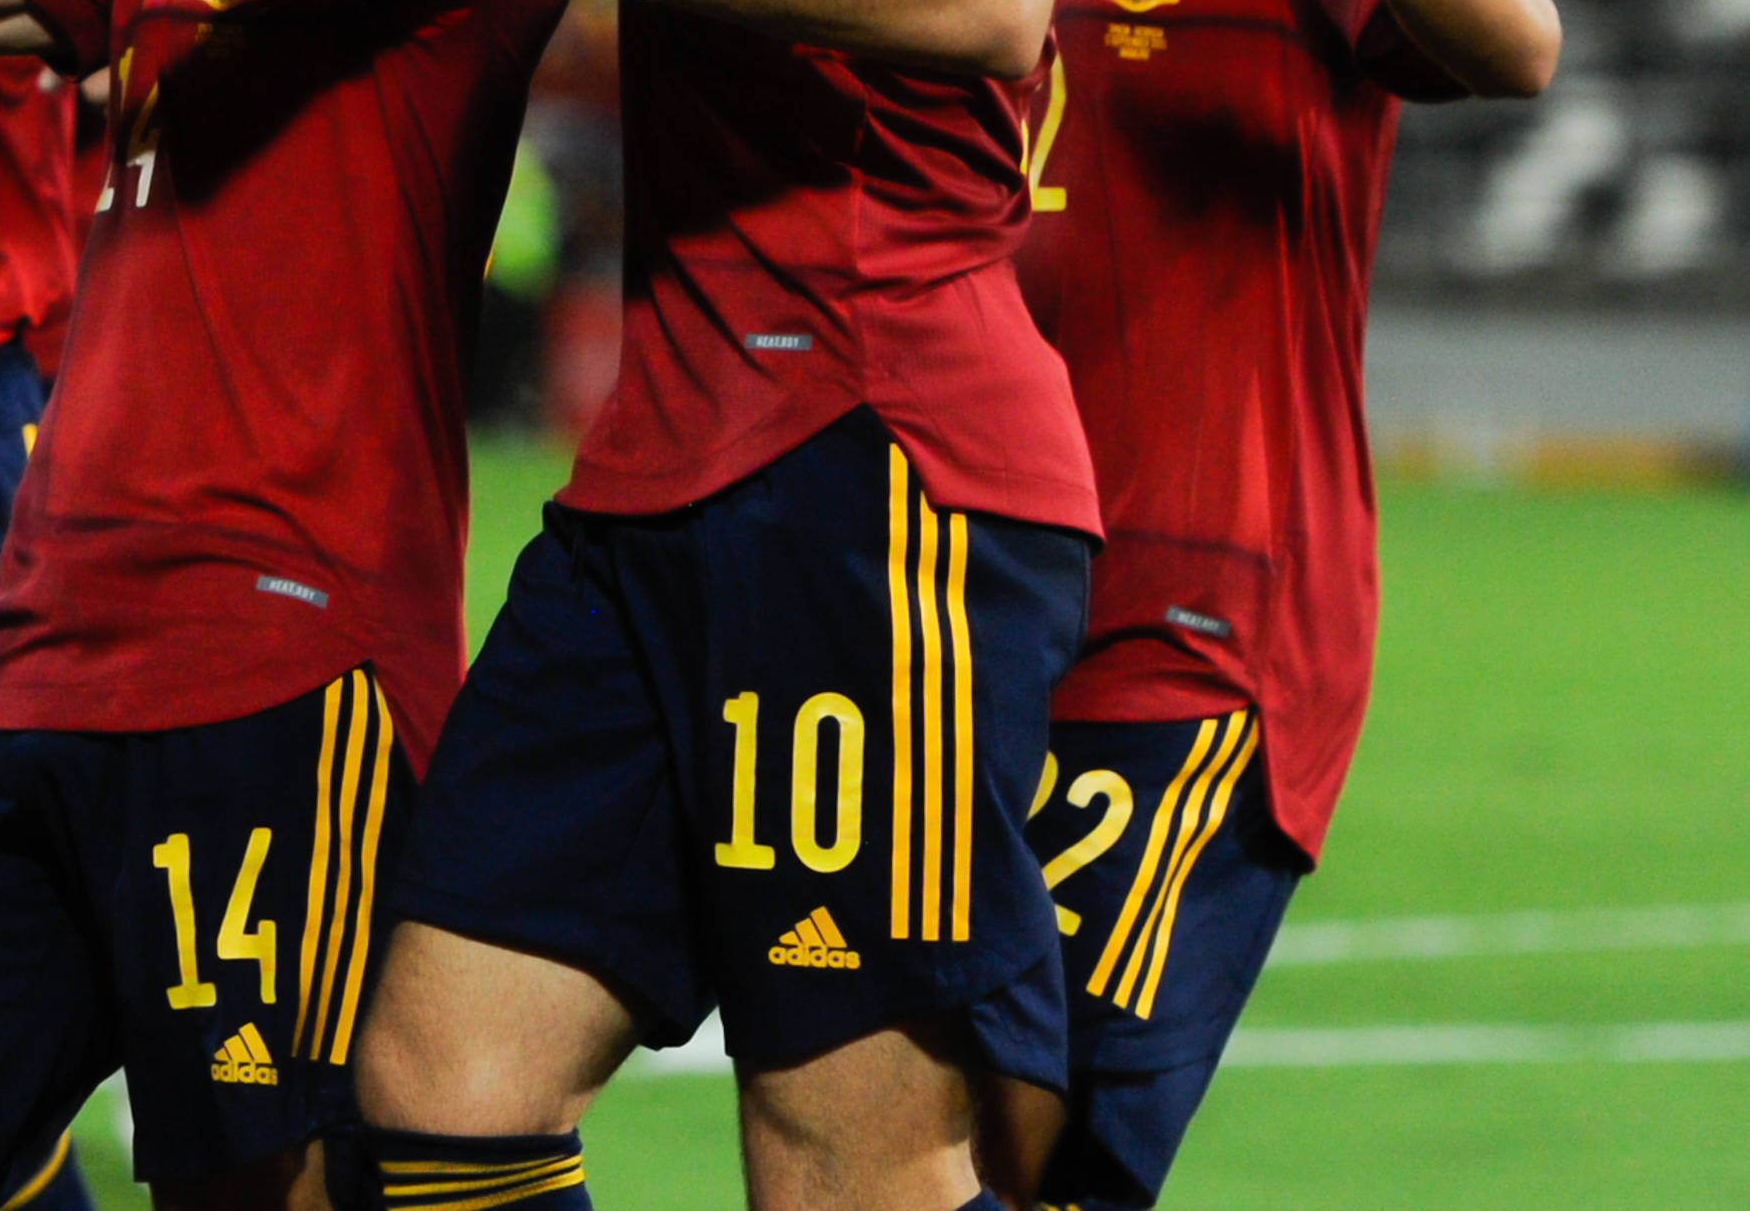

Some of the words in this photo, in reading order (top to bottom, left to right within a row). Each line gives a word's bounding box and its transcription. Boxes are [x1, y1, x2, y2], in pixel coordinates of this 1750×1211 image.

[1019, 52, 1067, 211] 2
[714, 691, 865, 873] 10
[1027, 750, 1134, 936] 2
[152, 827, 277, 1010] 14
[768, 943, 861, 970] adidas
[211, 1060, 278, 1086] adidas
